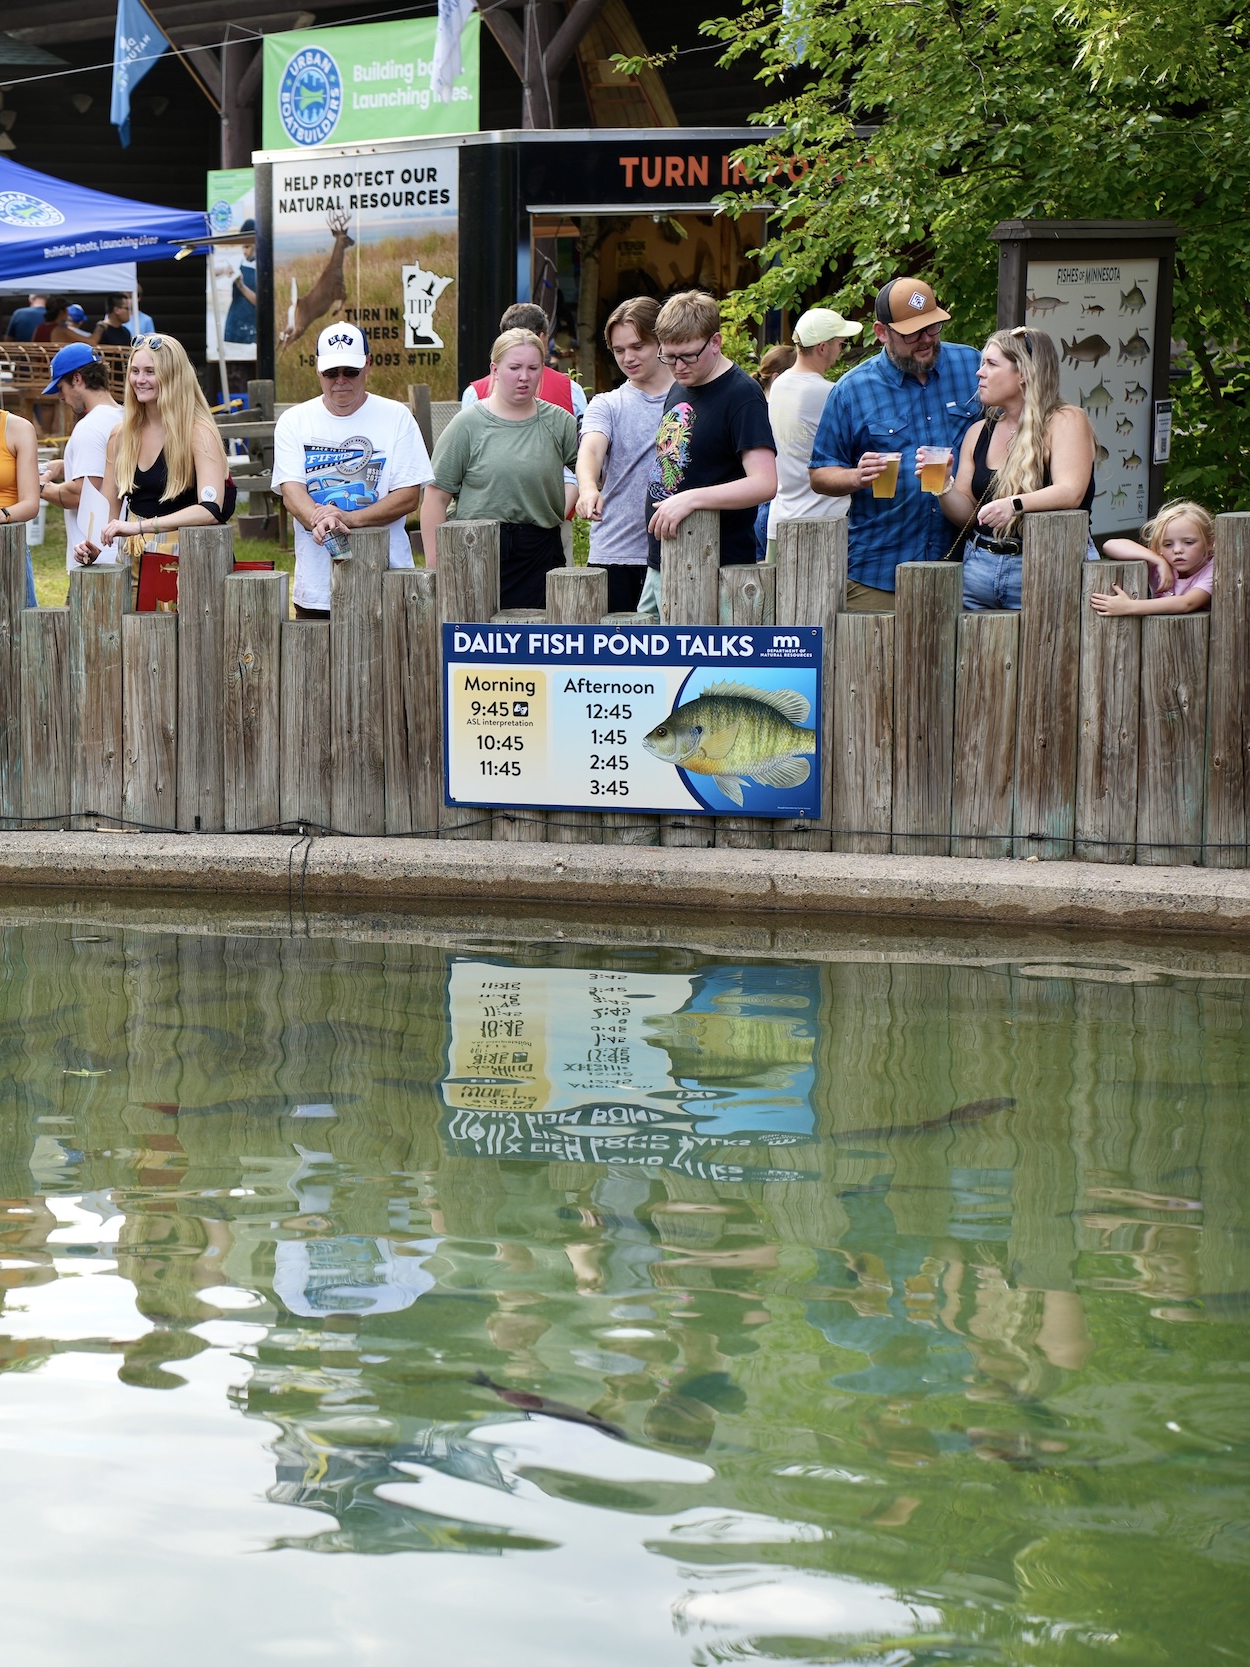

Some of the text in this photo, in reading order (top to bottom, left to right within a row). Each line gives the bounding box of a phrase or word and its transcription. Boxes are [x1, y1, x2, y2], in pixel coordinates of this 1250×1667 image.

[289, 51, 332, 76] URBAN
[353, 61, 414, 84] Building
[352, 85, 474, 110] Launching lies.
[280, 87, 340, 144] BOATBUILDERS
[284, 167, 438, 192] HELP PROTECT OUR
[618, 155, 709, 188] TURN
[279, 189, 451, 214] NATURAL RESOURCES
[43, 235, 159, 259] Building Boats, Launching Lives
[1056, 268, 1079, 285] FISHES
[1085, 267, 1121, 284] MINNESOTA
[345, 307, 399, 322] TURN IN
[406, 299, 433, 314] TIP
[407, 352, 442, 366] #TIP
[306, 451, 354, 465] FIFTIES
[453, 631, 754, 657] DAILY FISH POND TALKS
[464, 675, 536, 697] Morning
[563, 677, 655, 695] Afternoon
[470, 700, 510, 717] 9:45
[585, 703, 633, 720] 12:45
[466, 718, 534, 728] ASL interpretation
[476, 734, 525, 751] 10:45
[591, 729, 628, 745] 1:45
[479, 760, 522, 777] 11:45
[589, 754, 630, 771] 2:45
[589, 779, 630, 796] 3:45
